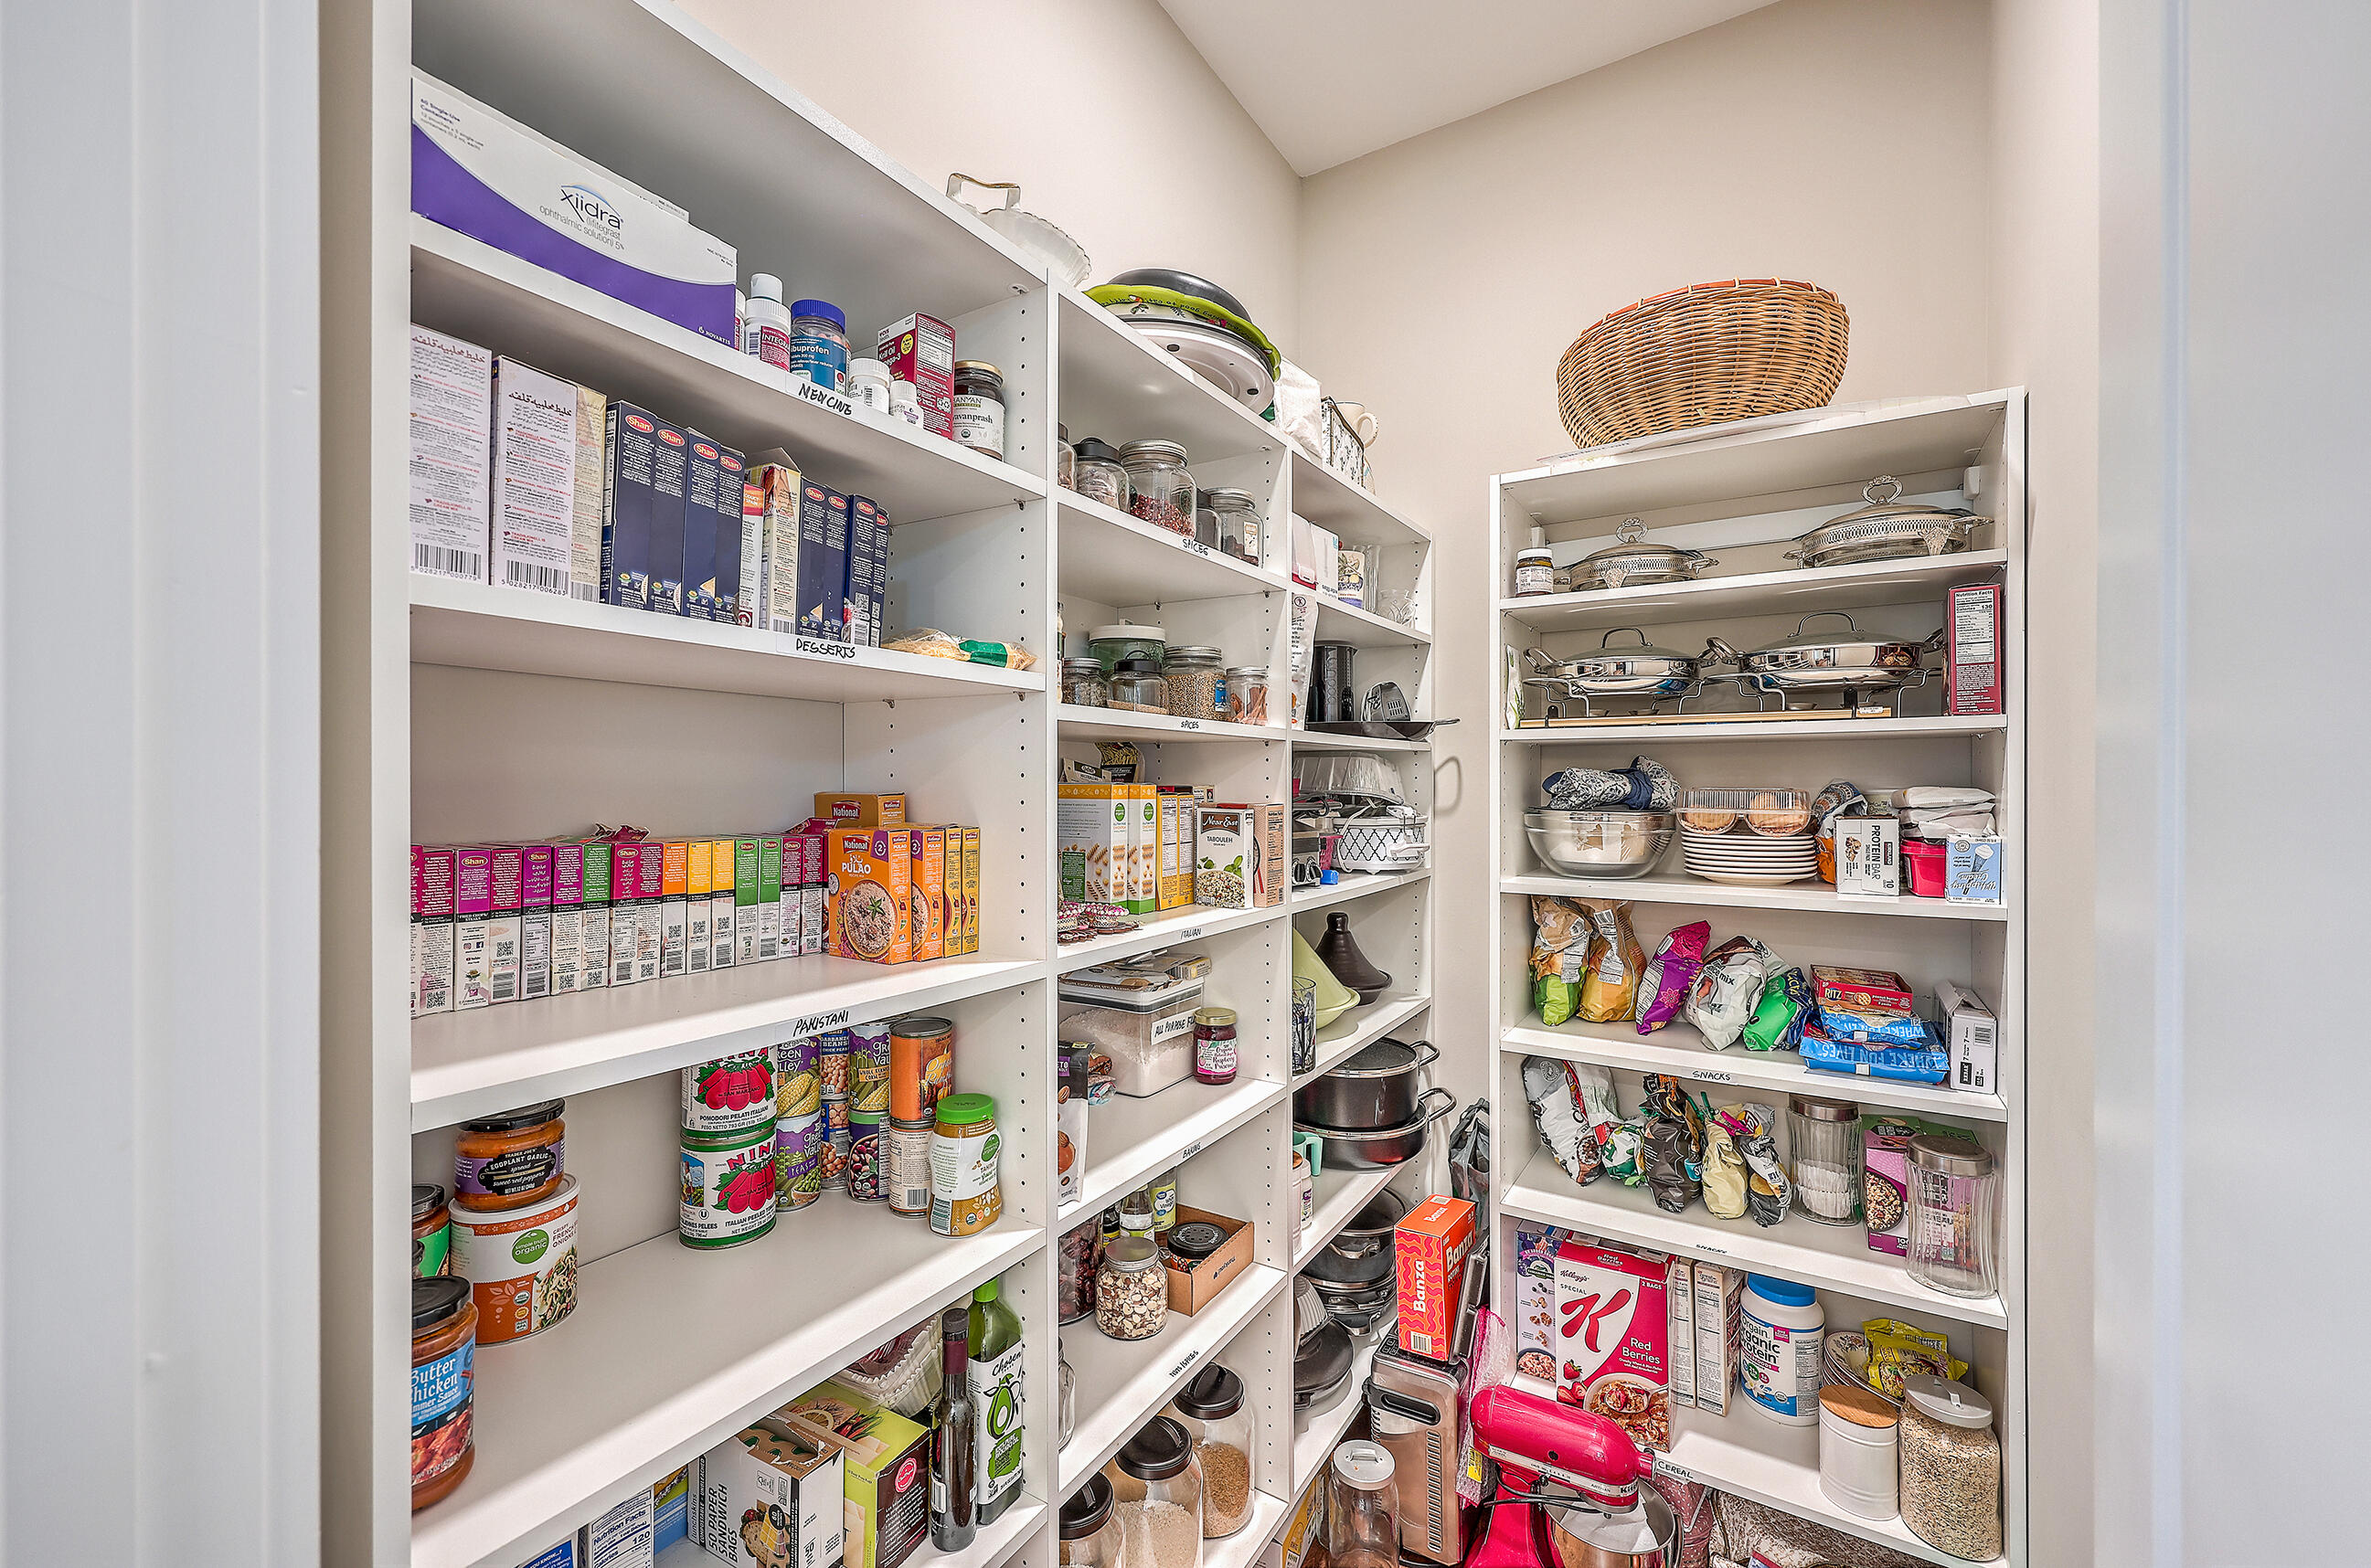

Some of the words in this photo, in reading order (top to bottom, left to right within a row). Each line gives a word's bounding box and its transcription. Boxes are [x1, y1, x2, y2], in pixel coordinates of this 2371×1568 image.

[539, 205, 582, 232] ophthalmic
[583, 225, 614, 248] solution)
[705, 330, 731, 345] NOVARTIS
[799, 383, 853, 416] MEDICINE
[628, 416, 651, 431] Shan
[660, 431, 682, 445] Shan
[696, 444, 717, 458] Shan
[720, 457, 739, 470] Shan
[806, 488, 824, 500] Shan
[829, 498, 846, 508] Shan
[857, 503, 874, 514] Shan
[876, 515, 888, 524] han
[420, 567, 447, 577] 028217
[509, 581, 537, 590] 028217
[796, 638, 856, 659] DESSERTS
[1181, 720, 1199, 729] SPICES
[833, 805, 858, 818] National
[1203, 815, 1222, 826] Near
[1222, 815, 1239, 828] East
[844, 838, 868, 851] National
[1871, 824, 1881, 863] PROTEIN
[842, 863, 871, 874] PULAO
[1871, 863, 1881, 880] BAR
[1886, 879, 1894, 889] 10
[1950, 878, 1996, 891] Whipping
[1180, 927, 1202, 939] ITALIAN
[1719, 972, 1736, 986] mix
[1824, 987, 1843, 1001] RITZ
[792, 1010, 849, 1038] PAKISTANI
[1154, 1024, 1164, 1037] ALL
[1822, 1044, 1855, 1062] LIVES
[1859, 1049, 1885, 1065] FUN
[1889, 1052, 1938, 1069] WHERE
[1692, 1070, 1731, 1081] SNACKS
[736, 1086, 761, 1096] MARZANO
[730, 1111, 750, 1119] PELATI
[1182, 1141, 1201, 1159] BAKING
[490, 1156, 526, 1171] EGGPLANT
[526, 1152, 548, 1161] GARLIC
[511, 1162, 532, 1173] spread
[791, 1162, 809, 1176] PEAS
[493, 1179, 512, 1187] sweet
[511, 1176, 523, 1184] red
[521, 1171, 546, 1186] peppers
[725, 1217, 747, 1227] ITALIAN
[748, 1208, 766, 1221] PEELED
[1424, 1206, 1449, 1223] Banza
[553, 1223, 569, 1234] CRISPY
[515, 1242, 548, 1256] organic
[1445, 1230, 1473, 1273] Banza
[1597, 1255, 1623, 1266] Berries
[1560, 1269, 1590, 1283] Kellogg's
[1413, 1259, 1426, 1313] Banza
[1559, 1283, 1587, 1296] SPECIAL
[1649, 1282, 1663, 1290] BAGS
[1559, 1288, 1632, 1353] K
[1630, 1337, 1652, 1351] Red
[1621, 1346, 1661, 1364] Berries
[992, 1351, 1022, 1377] Chosen
[411, 1358, 456, 1387] Butter
[411, 1372, 458, 1403] hicken
[437, 1385, 459, 1403] Sauce
[1657, 1460, 1694, 1478] CEREAL
[708, 1487, 718, 1531] PAPER
[594, 1520, 624, 1545] Nutrition
[624, 1510, 646, 1524] Facts
[718, 1483, 728, 1559] SANDWICH
[633, 1531, 650, 1544] 120
[708, 1532, 718, 1552] 50
[728, 1527, 739, 1563] BAGS
